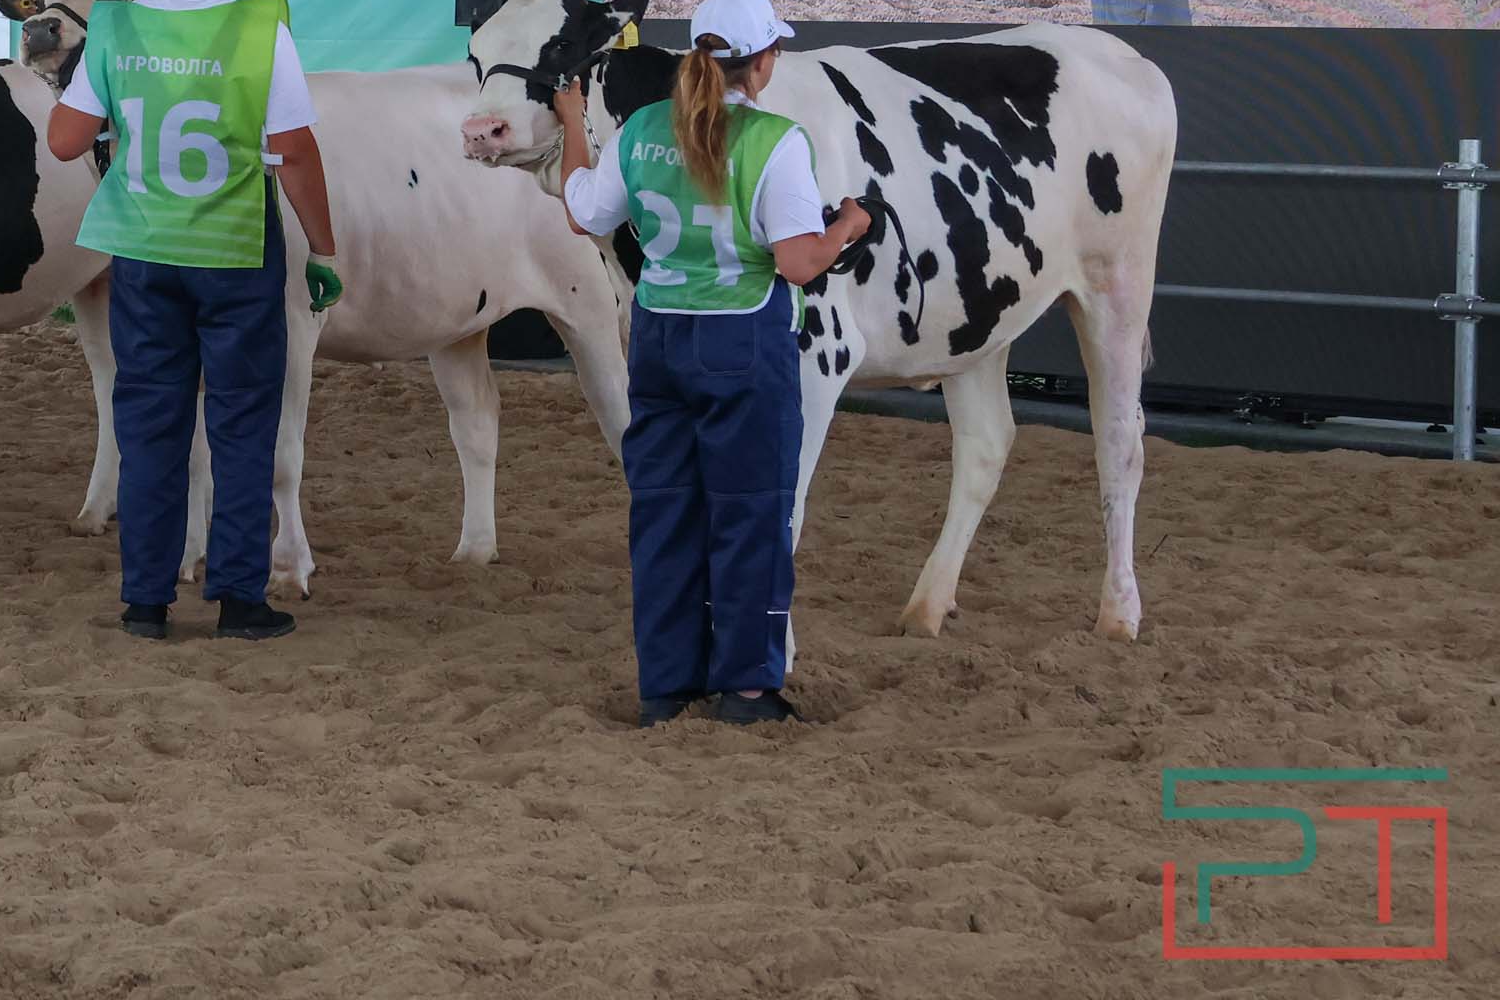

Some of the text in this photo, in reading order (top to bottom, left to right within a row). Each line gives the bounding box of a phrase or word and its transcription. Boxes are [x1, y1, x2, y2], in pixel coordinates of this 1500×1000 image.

[116, 55, 224, 76] АГРОВОЛГА
[120, 97, 229, 198] 16
[634, 190, 744, 287] 21
